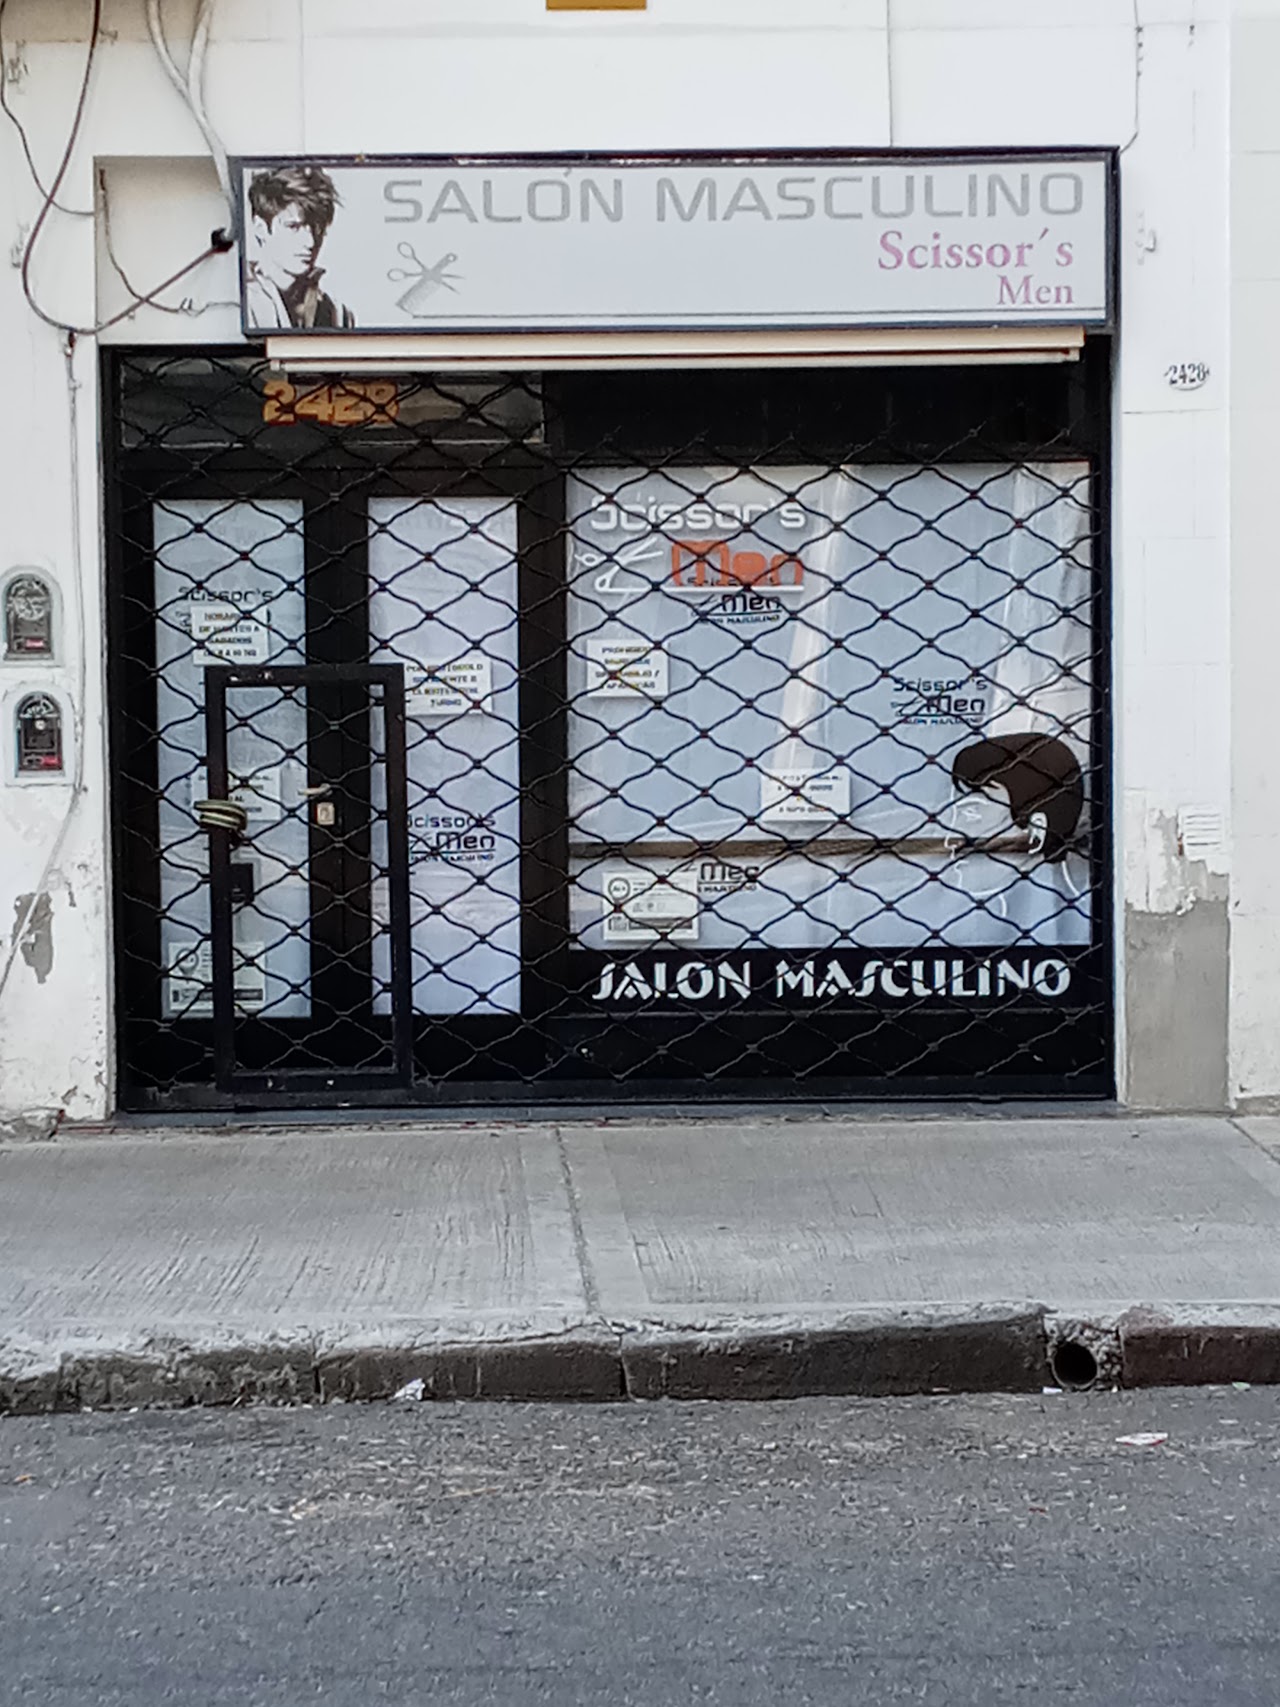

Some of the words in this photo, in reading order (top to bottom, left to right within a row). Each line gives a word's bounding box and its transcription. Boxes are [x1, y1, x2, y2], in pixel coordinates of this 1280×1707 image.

[383, 167, 624, 223] SALÓN
[656, 172, 1084, 222] MASCULINO
[996, 274, 1075, 305] Men
[1169, 362, 1206, 385] 2428
[775, 959, 1071, 998] MASCULINO
